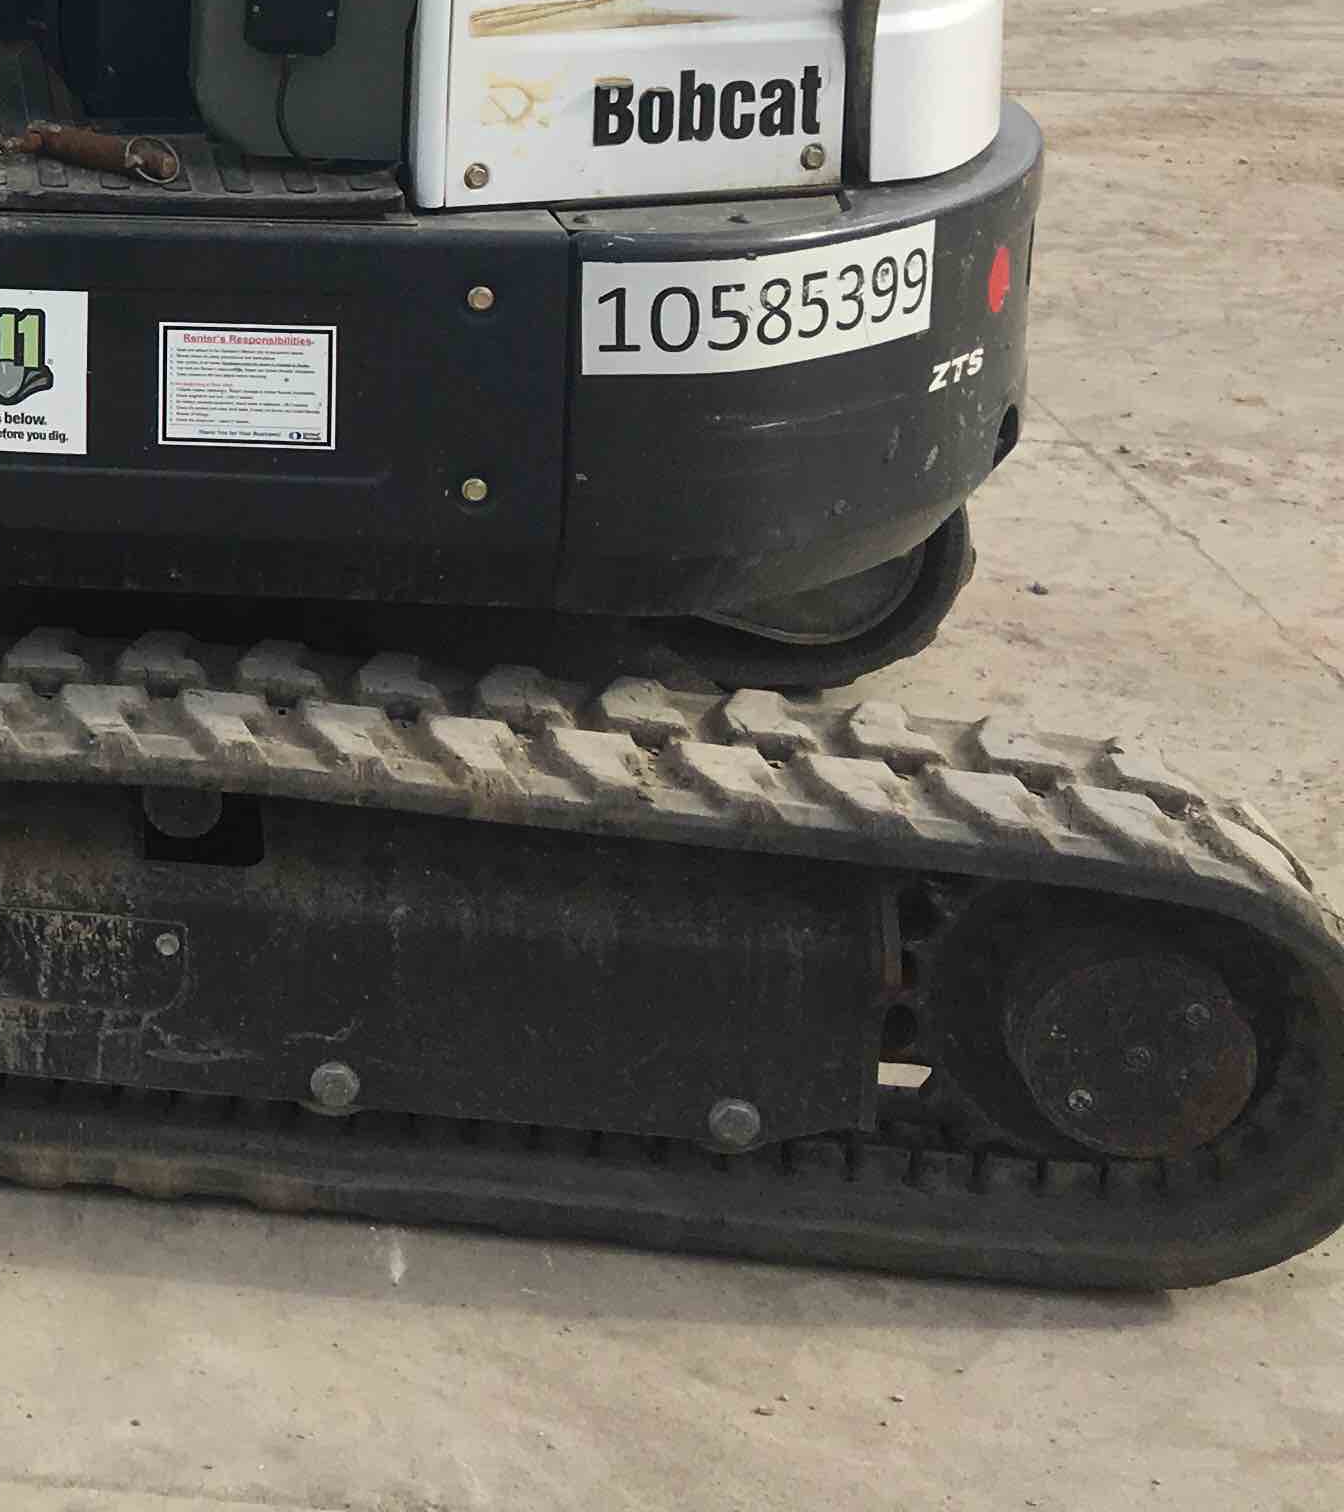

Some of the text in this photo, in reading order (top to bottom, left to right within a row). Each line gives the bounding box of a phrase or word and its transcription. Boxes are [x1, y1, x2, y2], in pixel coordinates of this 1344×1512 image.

[592, 65, 823, 147] Bobcat
[597, 247, 929, 353] 10585399
[928, 347, 985, 393] ZTS
[4, 411, 48, 426] below.
[26, 430, 47, 442] you
[48, 430, 69, 444] dig.
